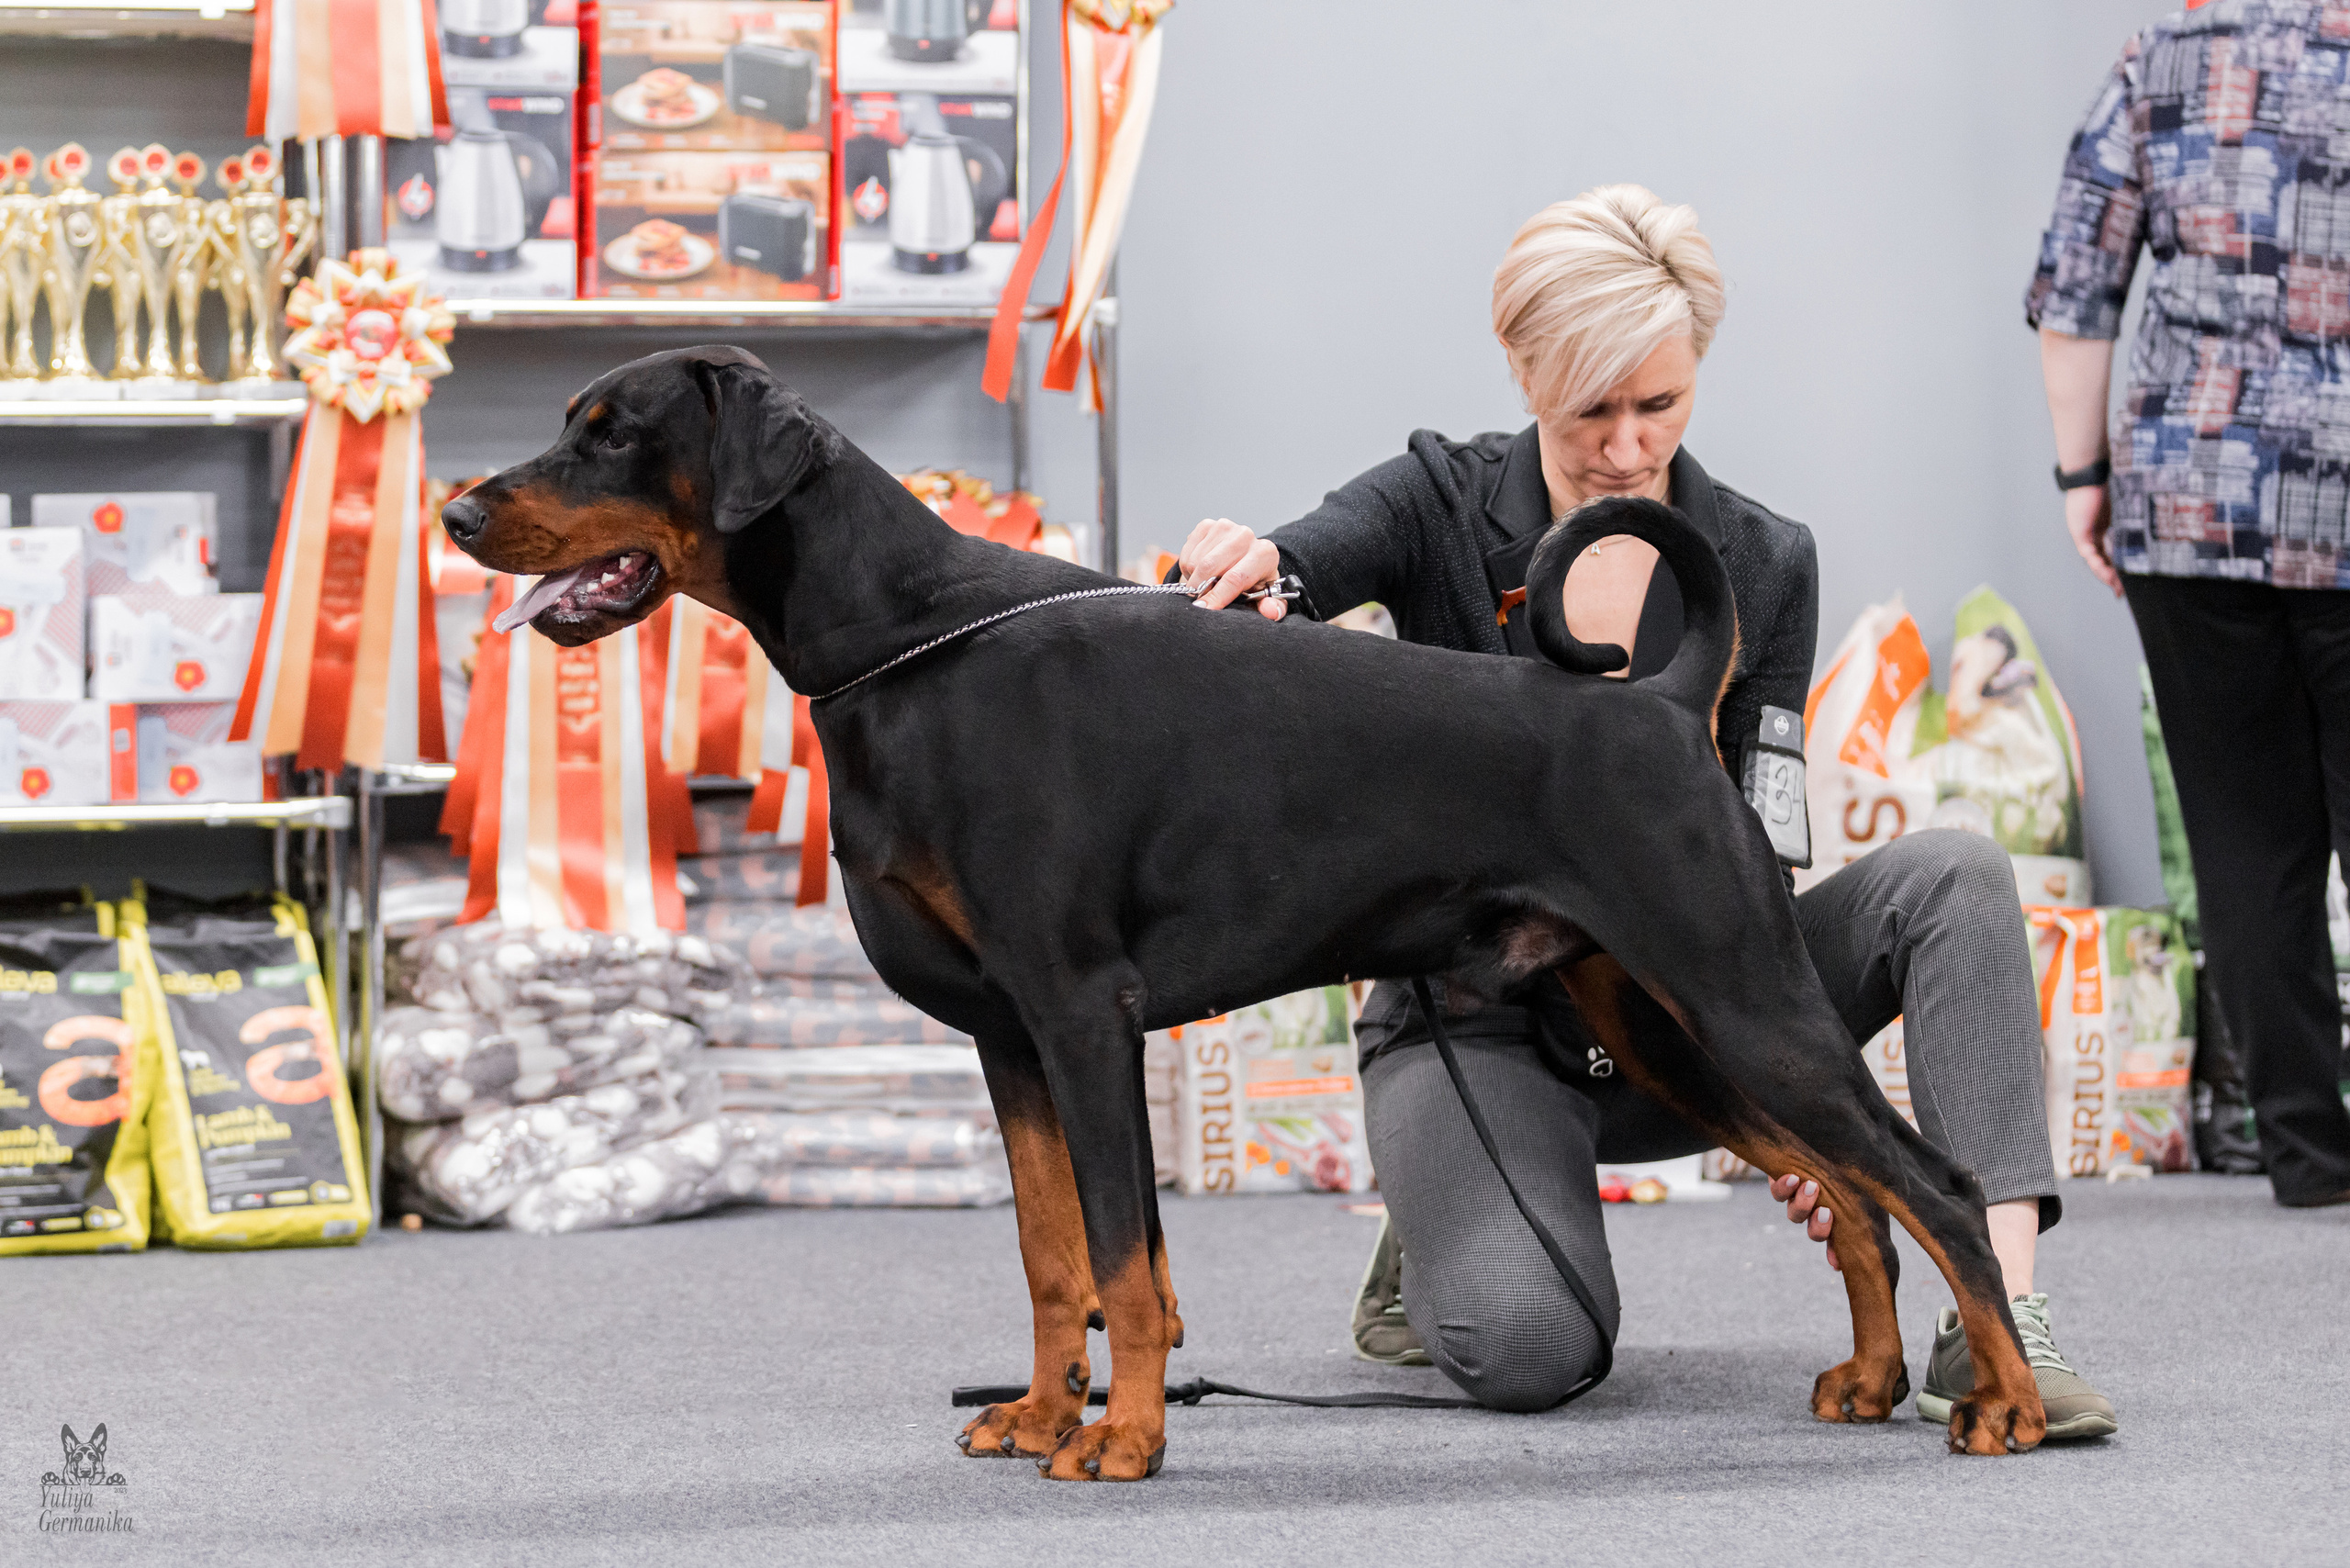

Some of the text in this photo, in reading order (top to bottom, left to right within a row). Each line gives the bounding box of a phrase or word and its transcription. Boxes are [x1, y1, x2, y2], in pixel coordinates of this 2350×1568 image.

[38, 1015, 134, 1127] a
[240, 1005, 337, 1105] a
[1197, 1040, 1235, 1193] SIRIUS
[2069, 1031, 2105, 1177] SIRIUS
